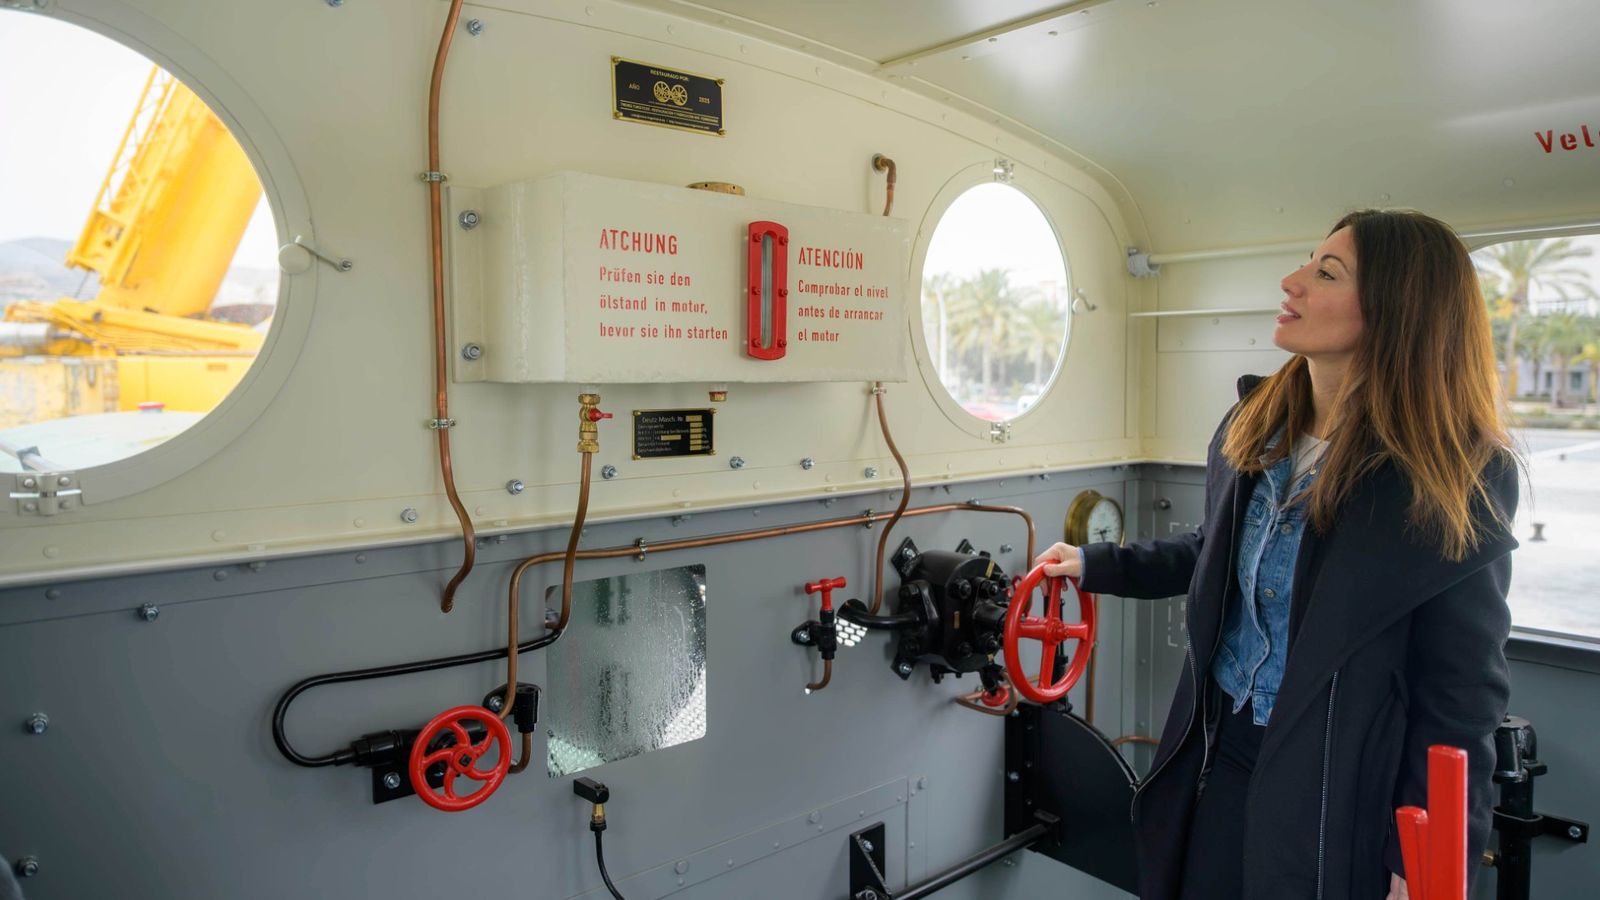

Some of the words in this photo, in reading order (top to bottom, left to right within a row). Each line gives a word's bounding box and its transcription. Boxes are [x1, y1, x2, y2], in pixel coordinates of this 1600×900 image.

[1534, 125, 1600, 153] Vel
[599, 228, 678, 255] ATCHUNG
[798, 247, 863, 270] ATENCIÓN
[599, 266, 641, 283] Prüfen
[647, 270, 665, 285] sie
[670, 271, 691, 286] den
[798, 279, 851, 297] Comprobar
[854, 285, 863, 297] el
[866, 285, 889, 299] nivel
[600, 294, 647, 311] ölstand
[655, 298, 666, 312] in
[798, 306, 825, 318] antes
[829, 306, 840, 319] de
[844, 309, 884, 321] arrancar
[600, 322, 635, 337] bevor
[640, 324, 658, 338] sie
[664, 324, 682, 339] ihn
[687, 326, 728, 340] starten
[798, 328, 808, 341] el
[811, 330, 840, 342] motor
